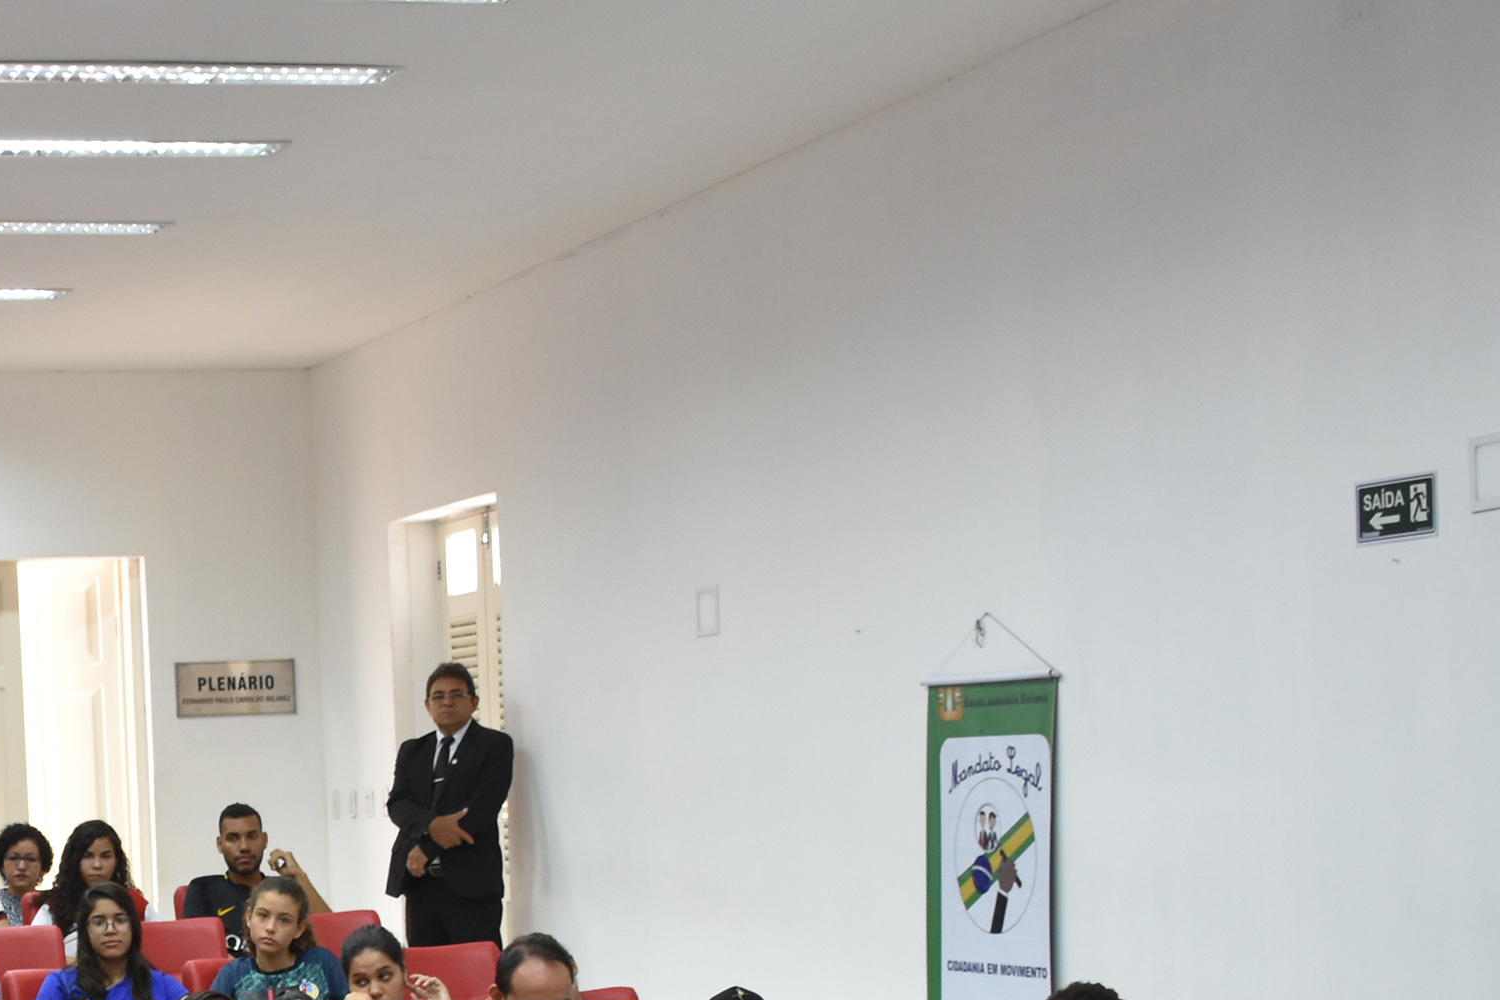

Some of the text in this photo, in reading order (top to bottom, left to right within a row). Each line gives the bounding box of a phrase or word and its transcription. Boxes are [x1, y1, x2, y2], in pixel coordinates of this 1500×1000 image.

[1363, 488, 1405, 512] SAÍDA
[197, 672, 275, 692] PLENÁRIO
[1006, 745, 1043, 798] Legal
[946, 960, 1048, 979] CIDADANIA EM MOVIMENTO
